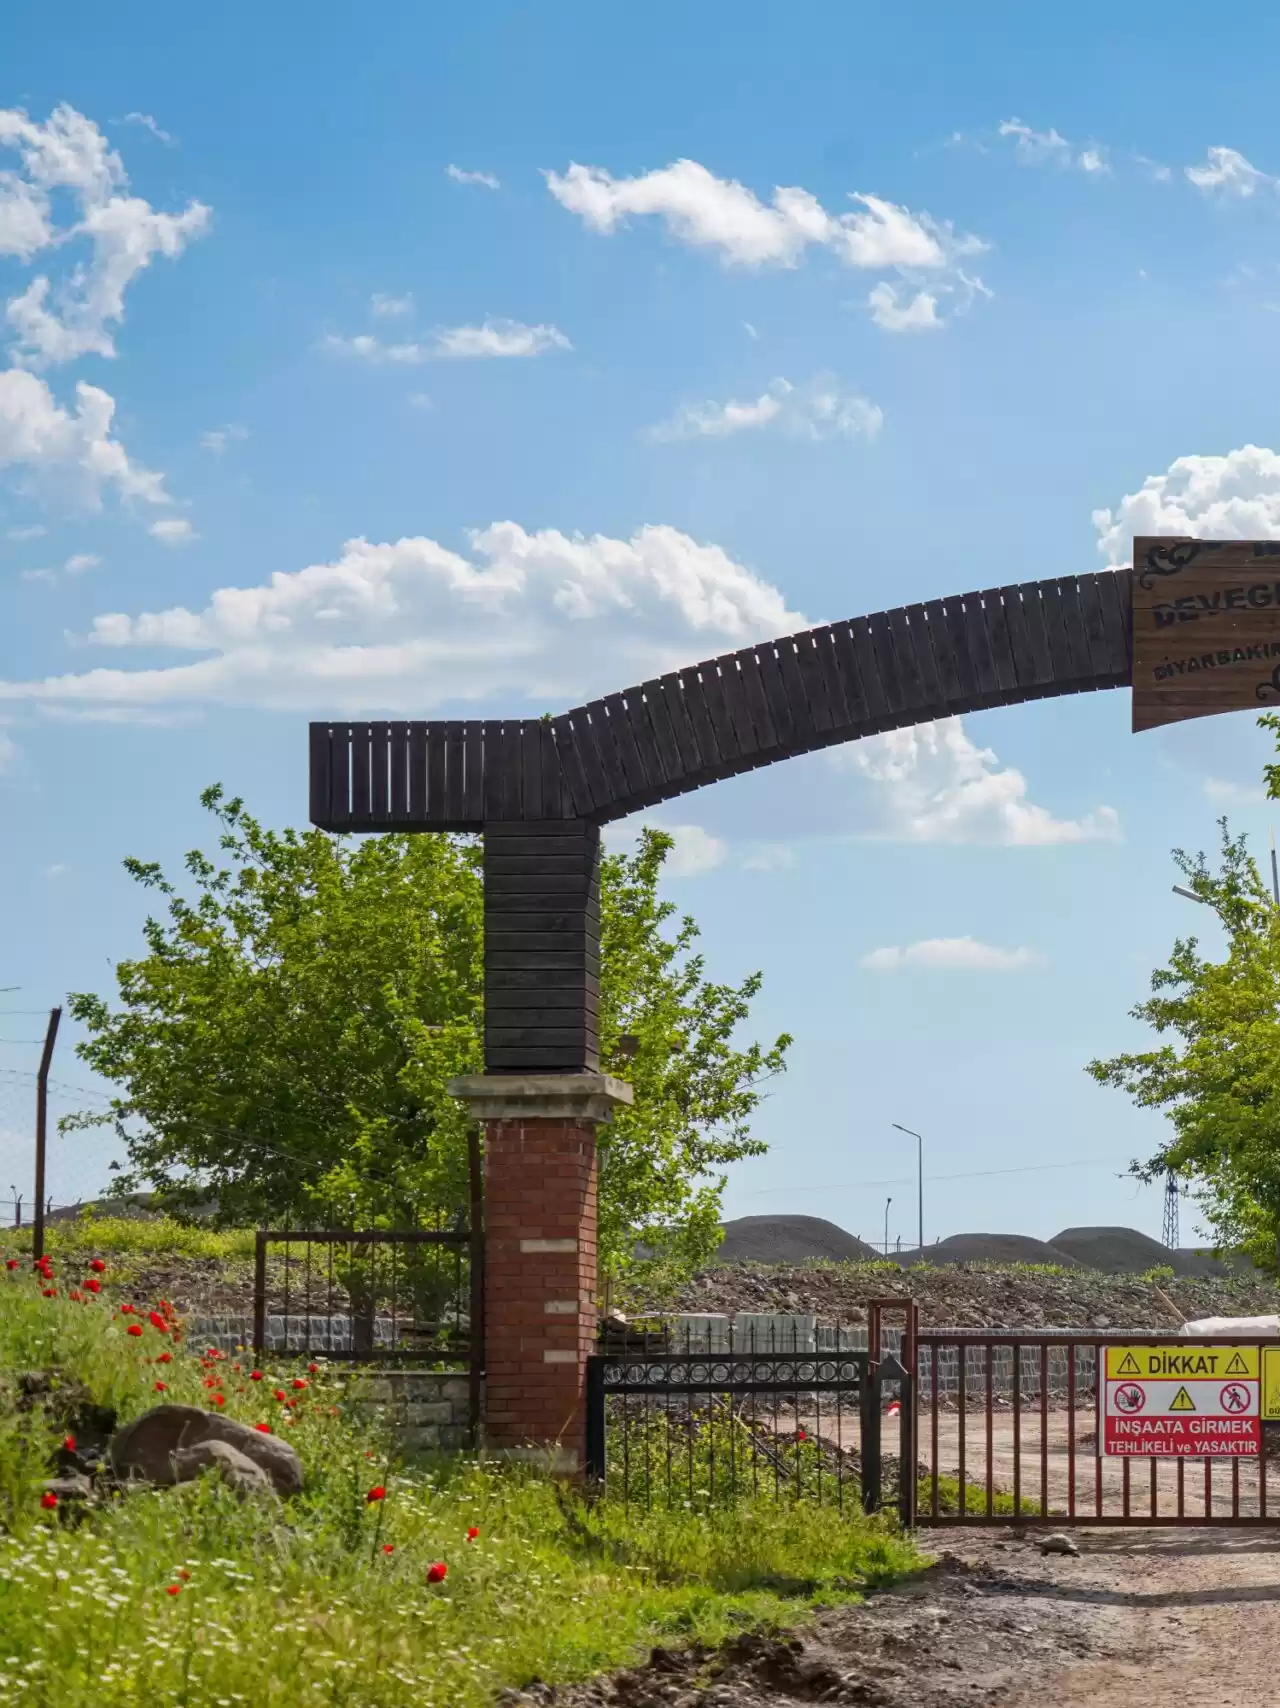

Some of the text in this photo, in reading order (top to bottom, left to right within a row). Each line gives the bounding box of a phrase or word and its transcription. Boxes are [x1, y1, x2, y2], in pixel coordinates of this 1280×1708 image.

[1149, 1351, 1219, 1374] DİKKAT
[1115, 1417, 1254, 1436] İNŞAATA GİRMEK
[1108, 1438, 1258, 1453] TEHLİKELİ ve YASAKTIR
